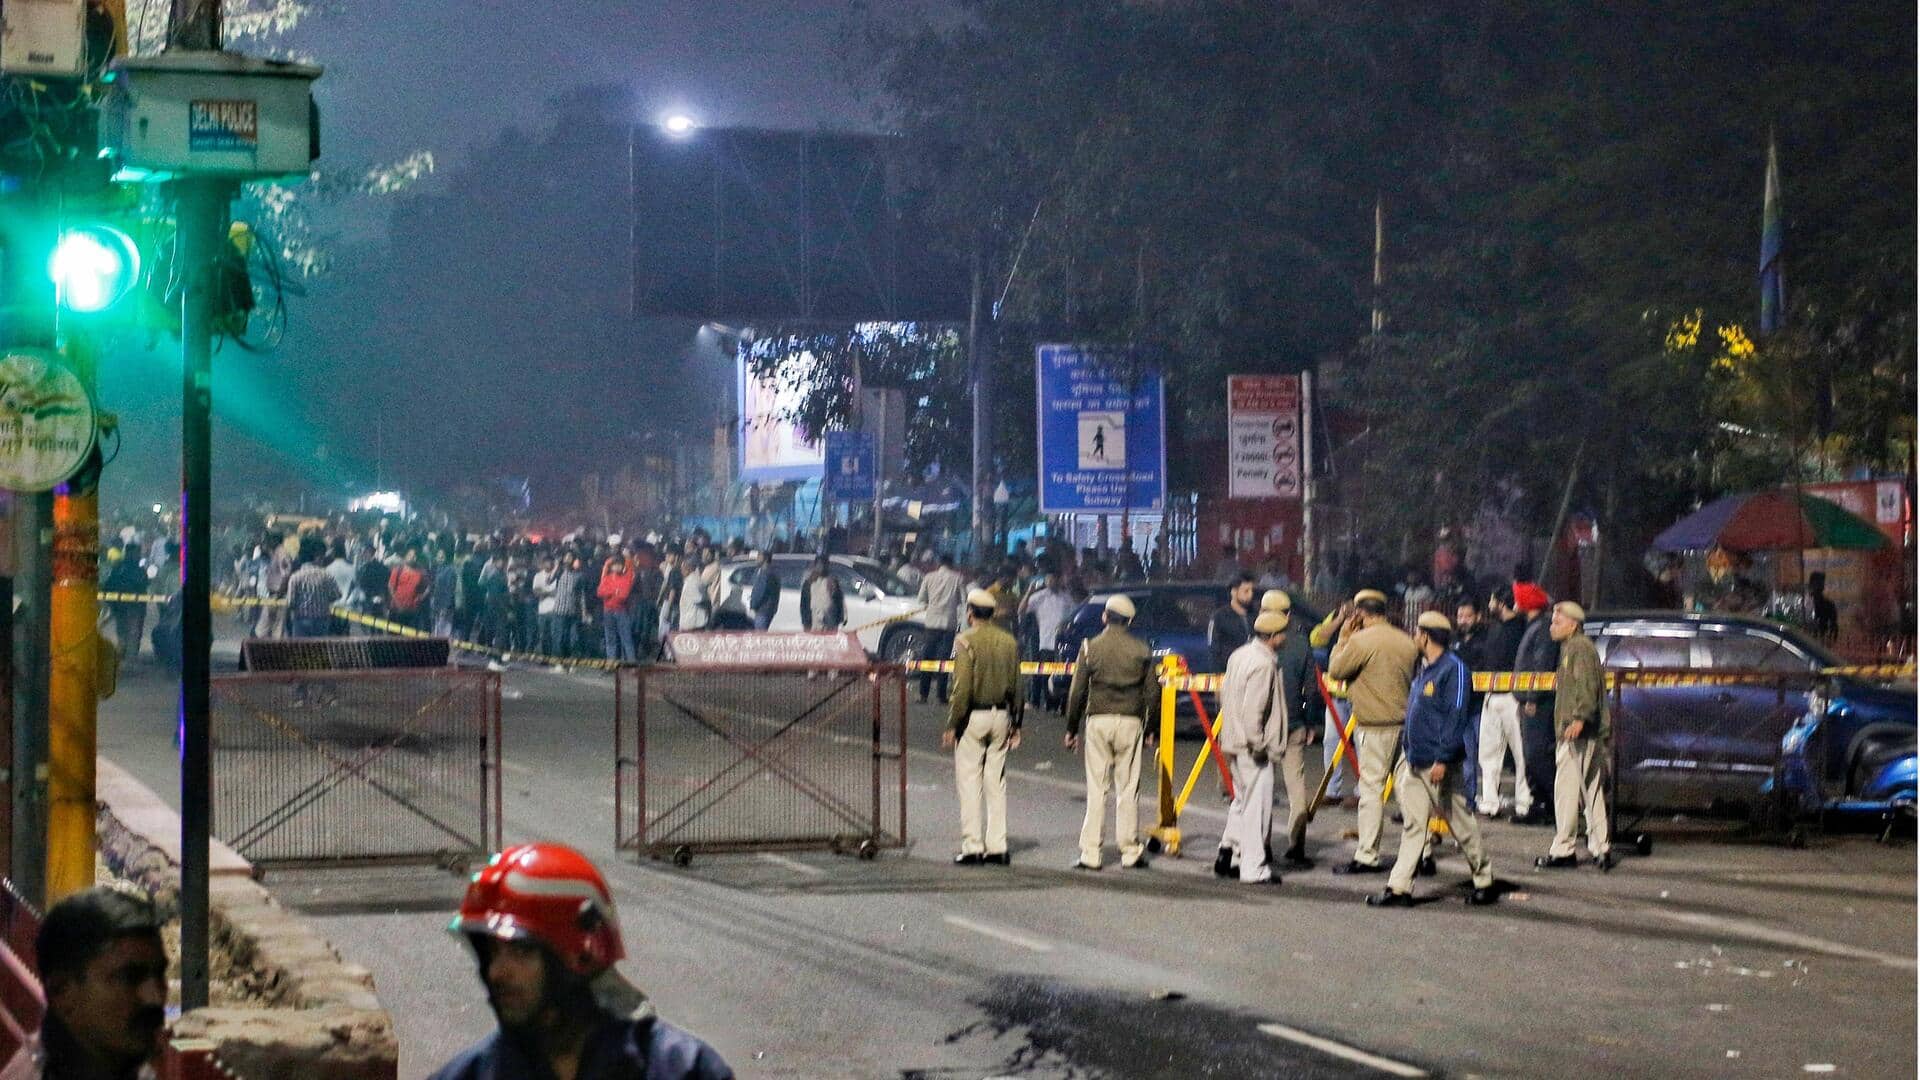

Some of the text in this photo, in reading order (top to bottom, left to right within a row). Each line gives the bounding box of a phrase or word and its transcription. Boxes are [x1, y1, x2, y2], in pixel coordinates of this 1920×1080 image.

[192, 103, 255, 132] DELHI POLICE
[1052, 471, 1062, 483] To
[1098, 470, 1125, 482] Cross
[1076, 482, 1127, 495] Please Use
[1084, 495, 1121, 507] Subway
